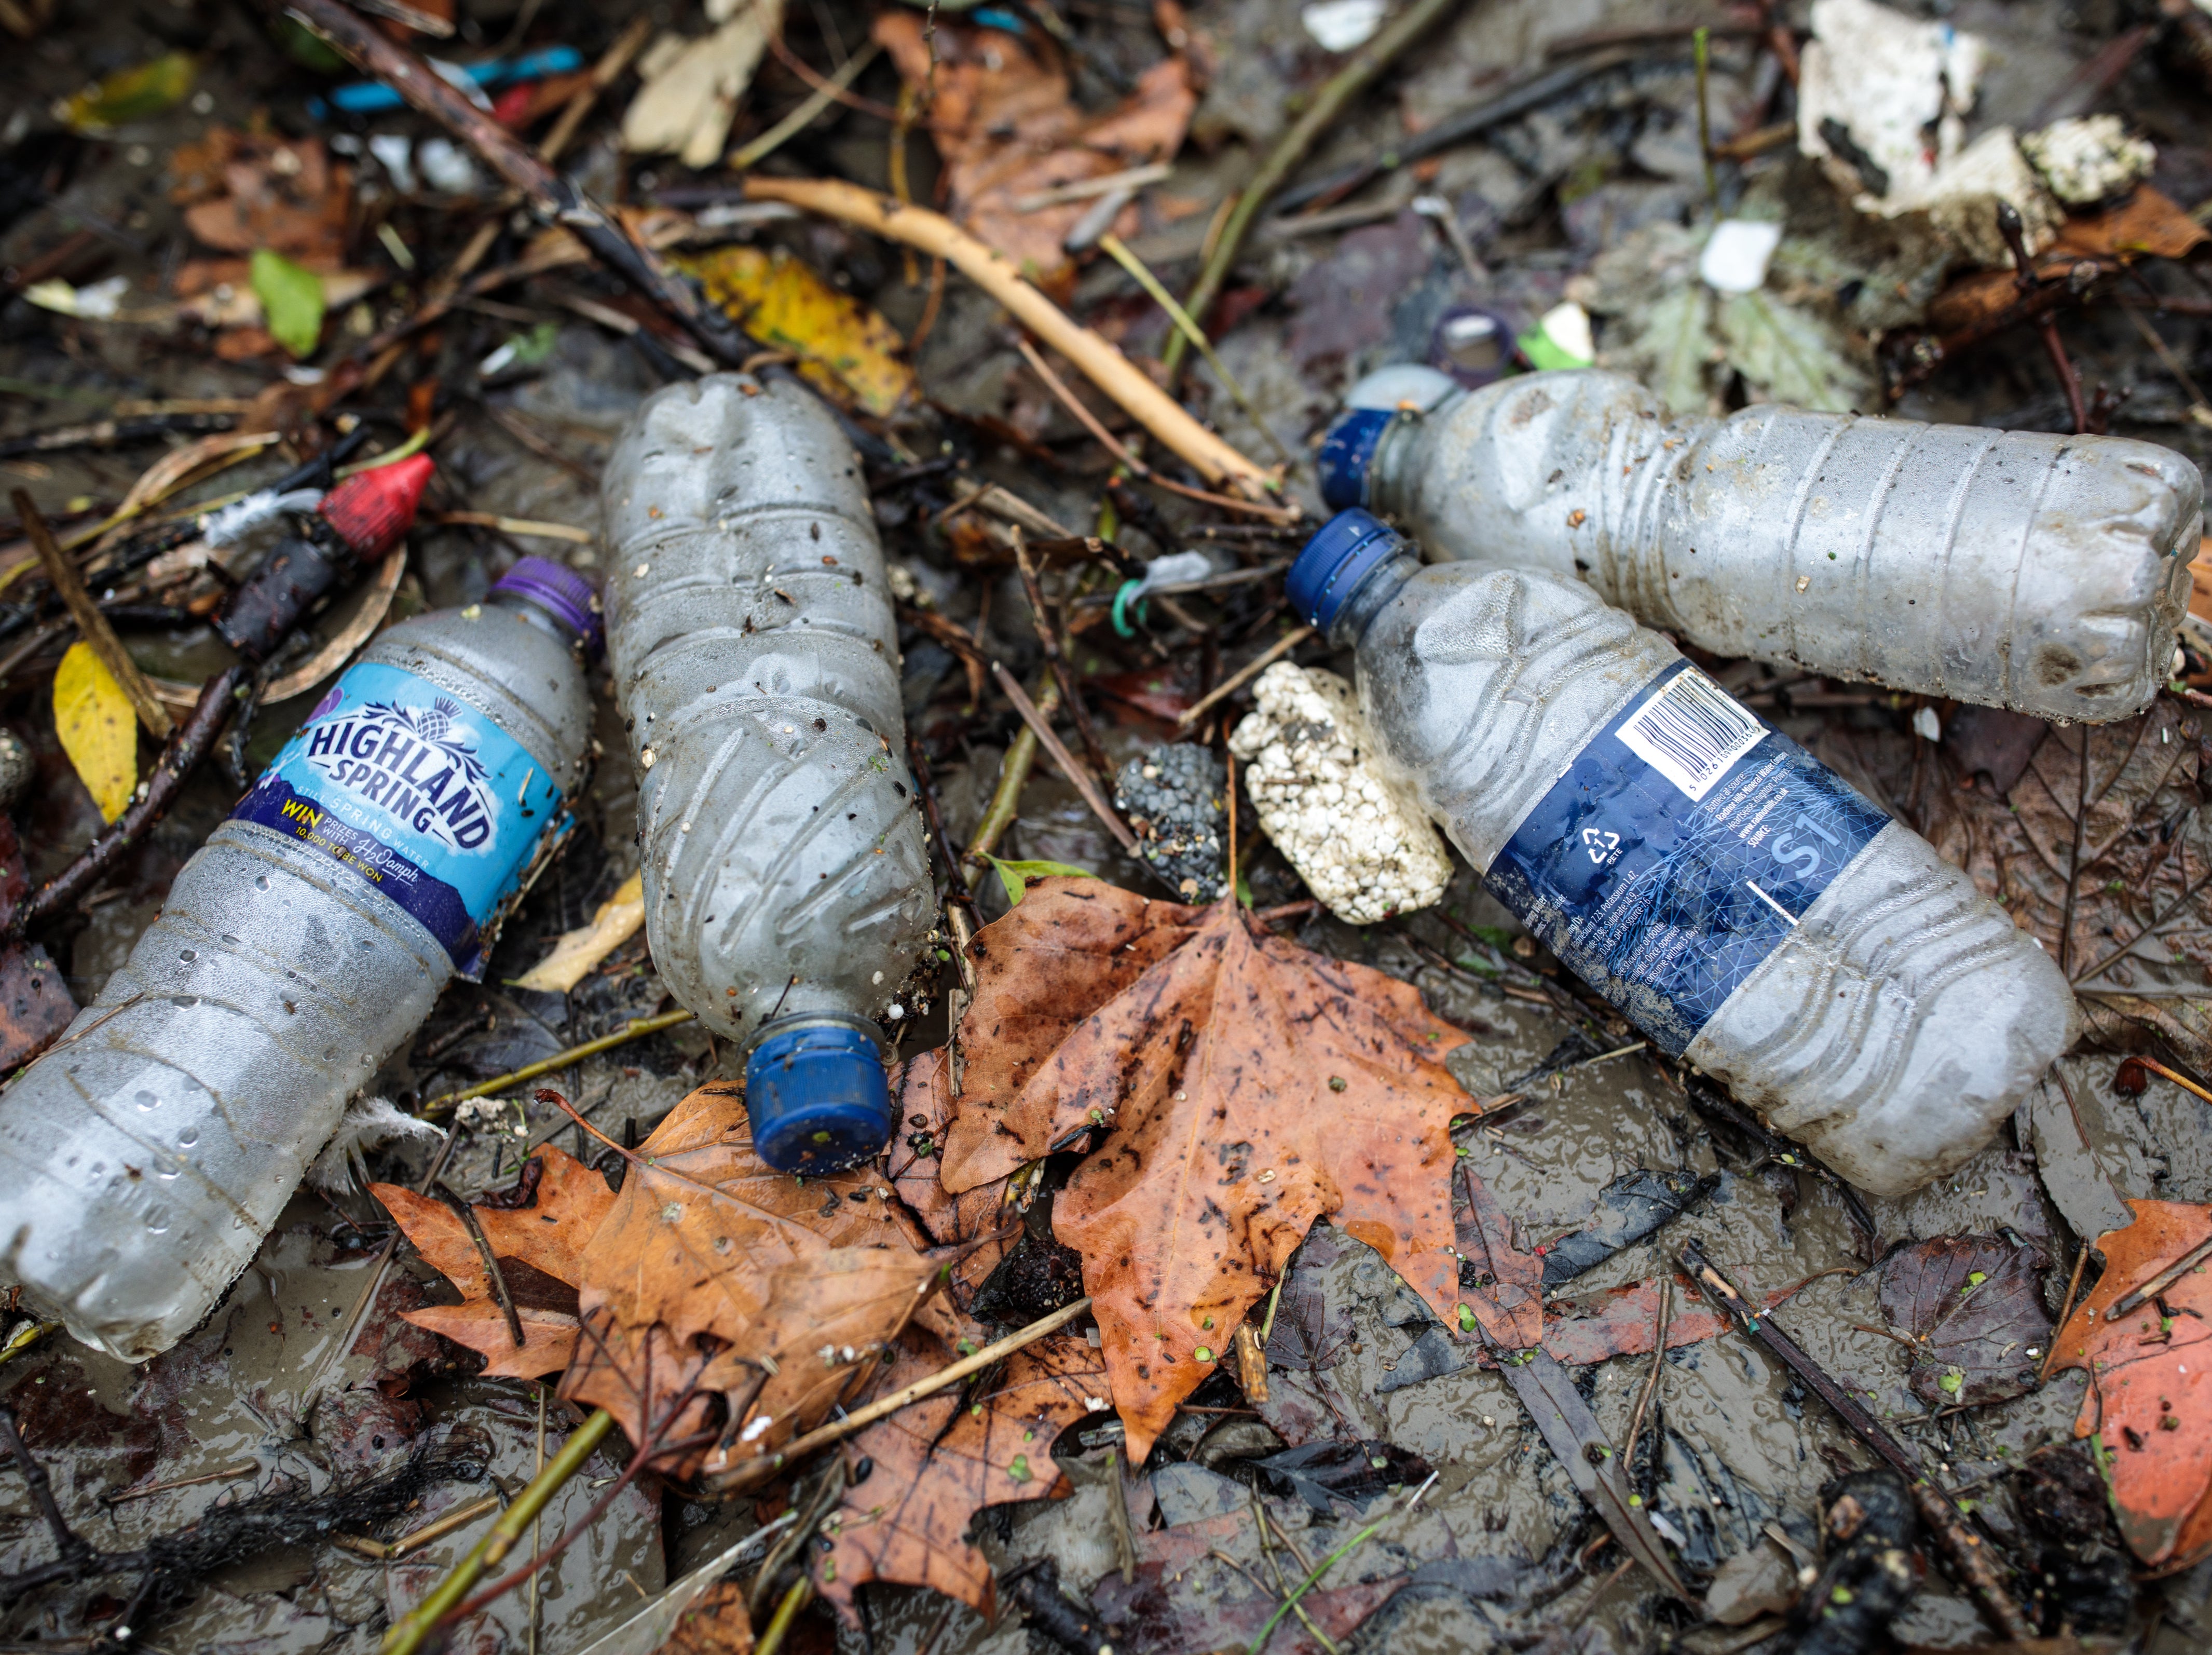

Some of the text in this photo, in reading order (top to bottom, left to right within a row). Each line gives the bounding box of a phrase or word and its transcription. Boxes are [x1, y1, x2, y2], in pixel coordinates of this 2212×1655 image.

[307, 721, 493, 850] HIGHLAND
[1700, 750, 1731, 780] 026109
[329, 758, 435, 833] SPRING
[1704, 771, 1747, 813] Bottled at source:
[1716, 800, 1738, 822] Radnor
[1732, 791, 1746, 804] Hills
[1741, 773, 1763, 795] Mineral
[1757, 761, 1776, 778] Water
[1725, 801, 1756, 831] Heartsease,
[1751, 780, 1777, 804] Knighton,
[1771, 765, 1791, 783] Powys,
[1737, 786, 1788, 839] www.radnorhills.co.uk
[280, 798, 324, 829] WIN
[296, 785, 430, 869] STILL SPRING WATER
[323, 816, 359, 840] PRIZES
[295, 826, 327, 847] 10,000
[342, 851, 357, 864] BE
[356, 861, 383, 883] WON
[322, 826, 348, 845] WITH
[1594, 838, 1605, 848] 1
[1606, 848, 1623, 865] PETE
[1747, 823, 1772, 848] SOURCE:
[1770, 813, 1842, 880] S1
[1531, 894, 1548, 913] Water
[1600, 881, 1628, 912] Potassium
[1604, 903, 1629, 929] Sulphate
[1613, 929, 1624, 941] pH
[1619, 923, 1629, 932] at
[1627, 906, 1644, 926] source
[1614, 966, 1626, 978] See
[1621, 943, 1645, 969] shoulder
[1641, 935, 1651, 946] of
[1646, 919, 1668, 940] bottle.
[1626, 959, 1650, 985] sunlight.
[1644, 945, 1661, 962] Once
[1657, 925, 1681, 950] opened
[1644, 958, 1669, 985] consume
[1664, 941, 1685, 961] within
[1679, 935, 1688, 944] 3
[1684, 923, 1702, 940] days.
